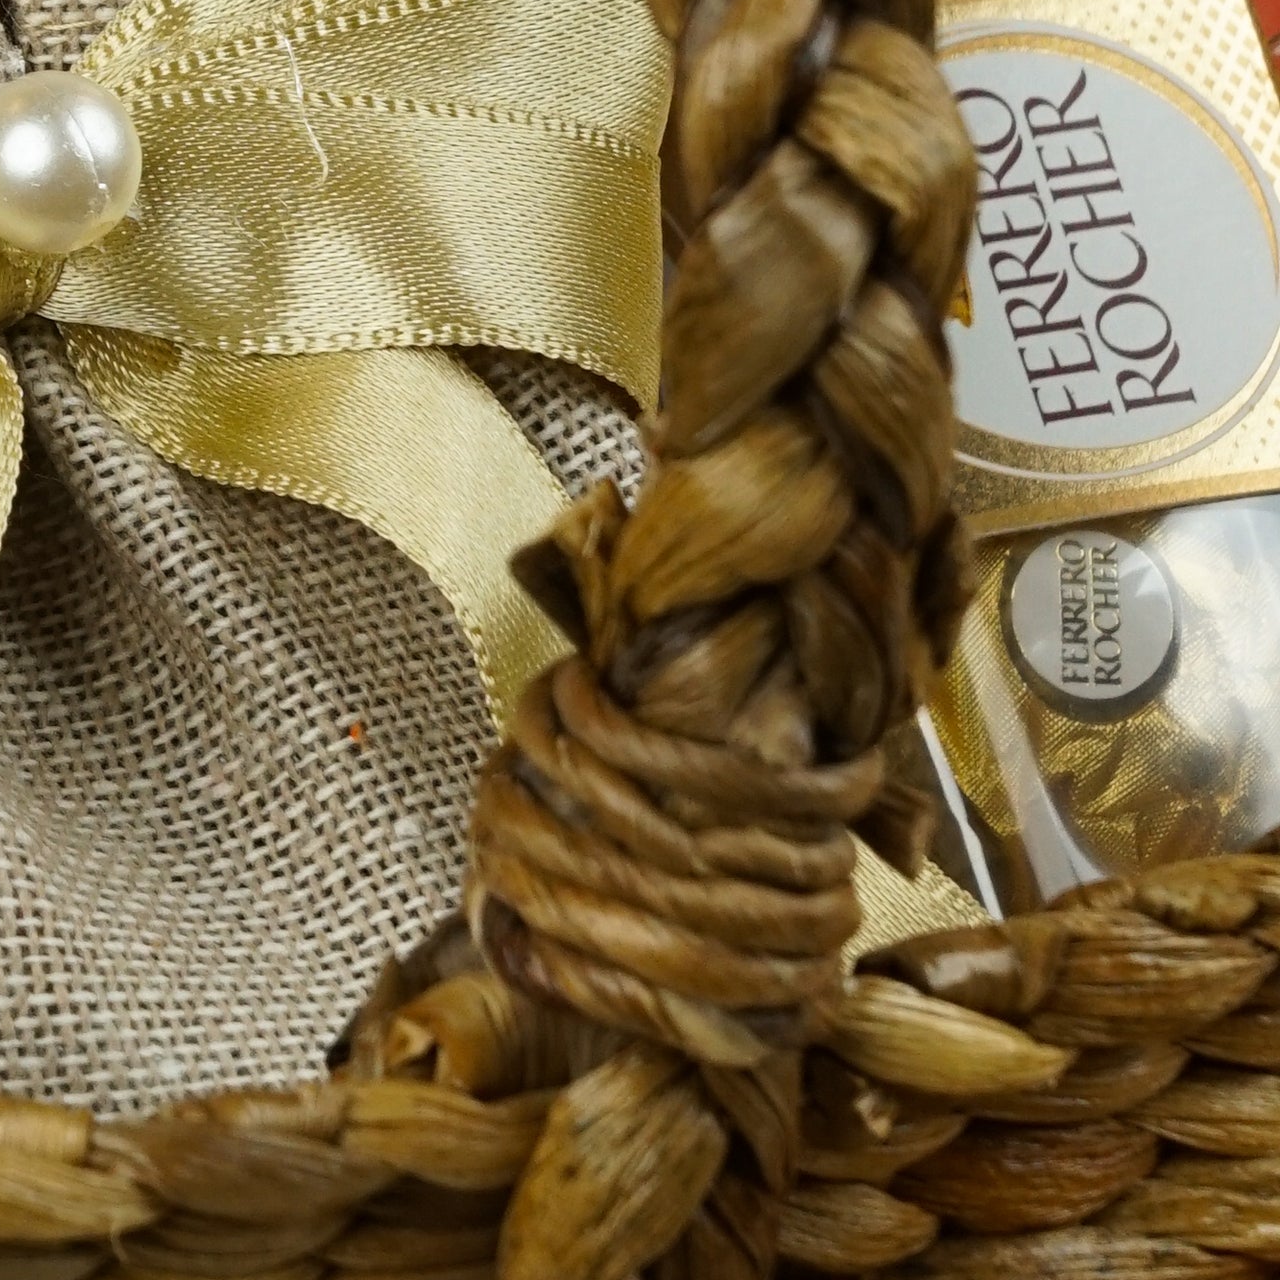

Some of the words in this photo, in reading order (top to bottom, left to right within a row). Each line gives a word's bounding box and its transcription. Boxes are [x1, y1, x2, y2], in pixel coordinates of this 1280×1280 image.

[1022, 66, 1198, 413] ROCHER
[1055, 539, 1090, 686] FERRERO
[1089, 540, 1123, 687] ROCHER
